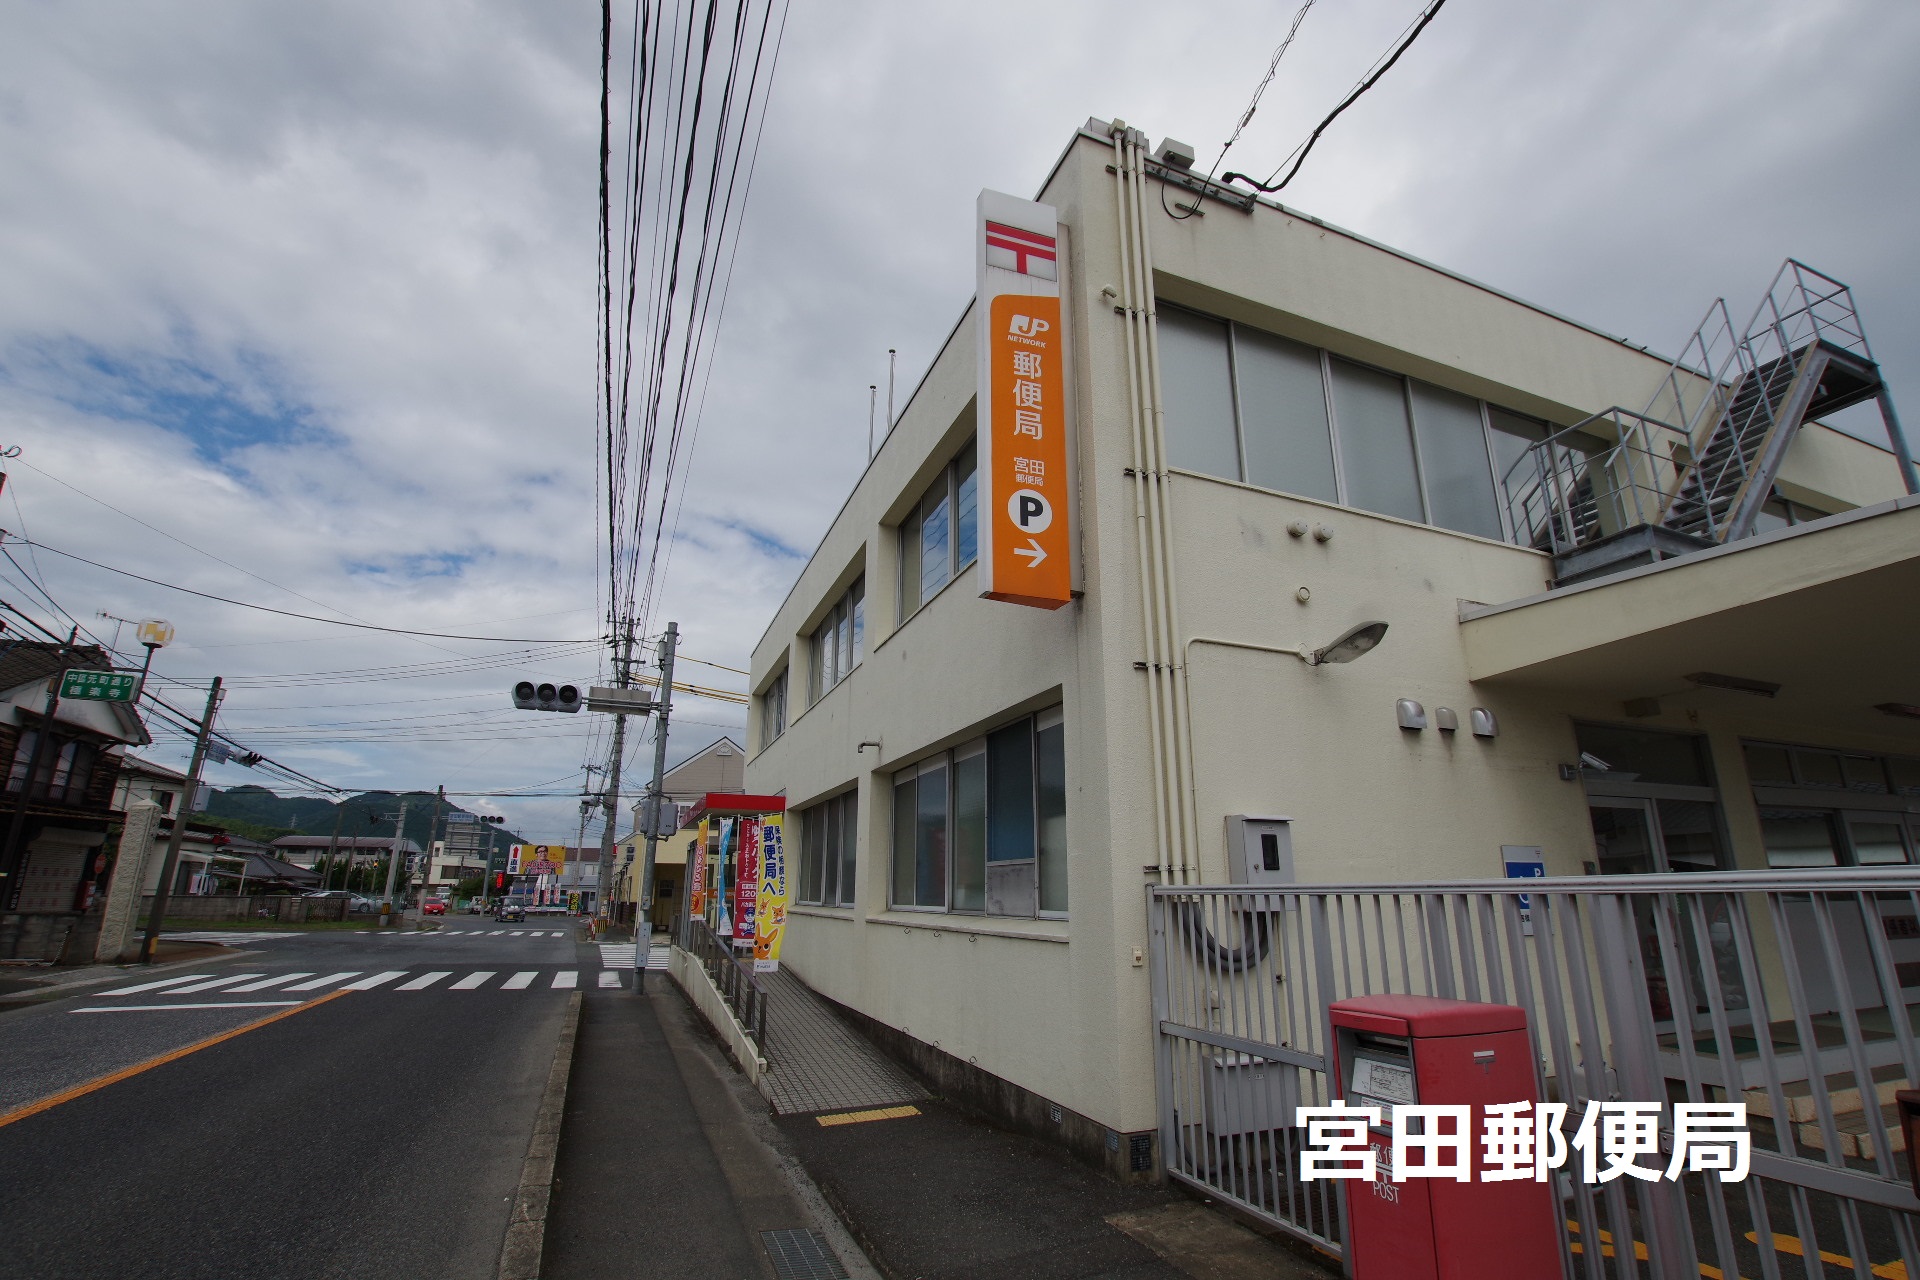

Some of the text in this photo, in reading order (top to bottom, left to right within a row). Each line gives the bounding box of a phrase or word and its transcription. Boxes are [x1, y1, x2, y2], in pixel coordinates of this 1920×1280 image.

[1007, 334, 1046, 348] NETWORK
[1012, 350, 1043, 440] 郵便局
[1013, 457, 1045, 476] 宮田
[1016, 473, 1044, 487] 郵便局
[1019, 495, 1044, 527] P
[762, 825, 777, 895] 郵便局へ
[1372, 1180, 1400, 1204] POST
